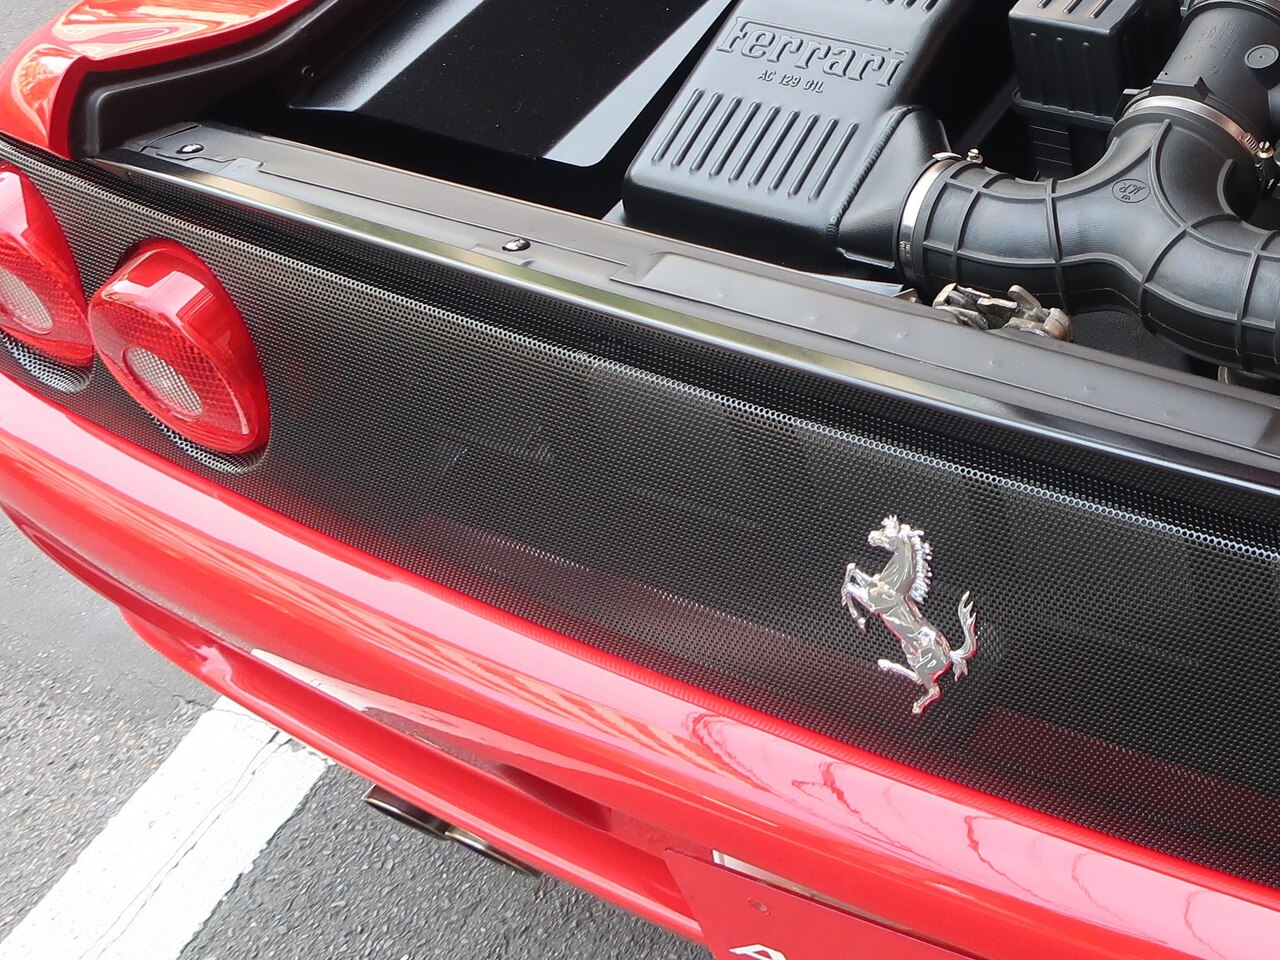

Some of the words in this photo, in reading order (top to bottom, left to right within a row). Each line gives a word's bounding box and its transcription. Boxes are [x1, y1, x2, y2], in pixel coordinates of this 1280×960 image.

[717, 16, 909, 87] Ferrari
[757, 69, 776, 82] AC
[779, 73, 801, 88] 129
